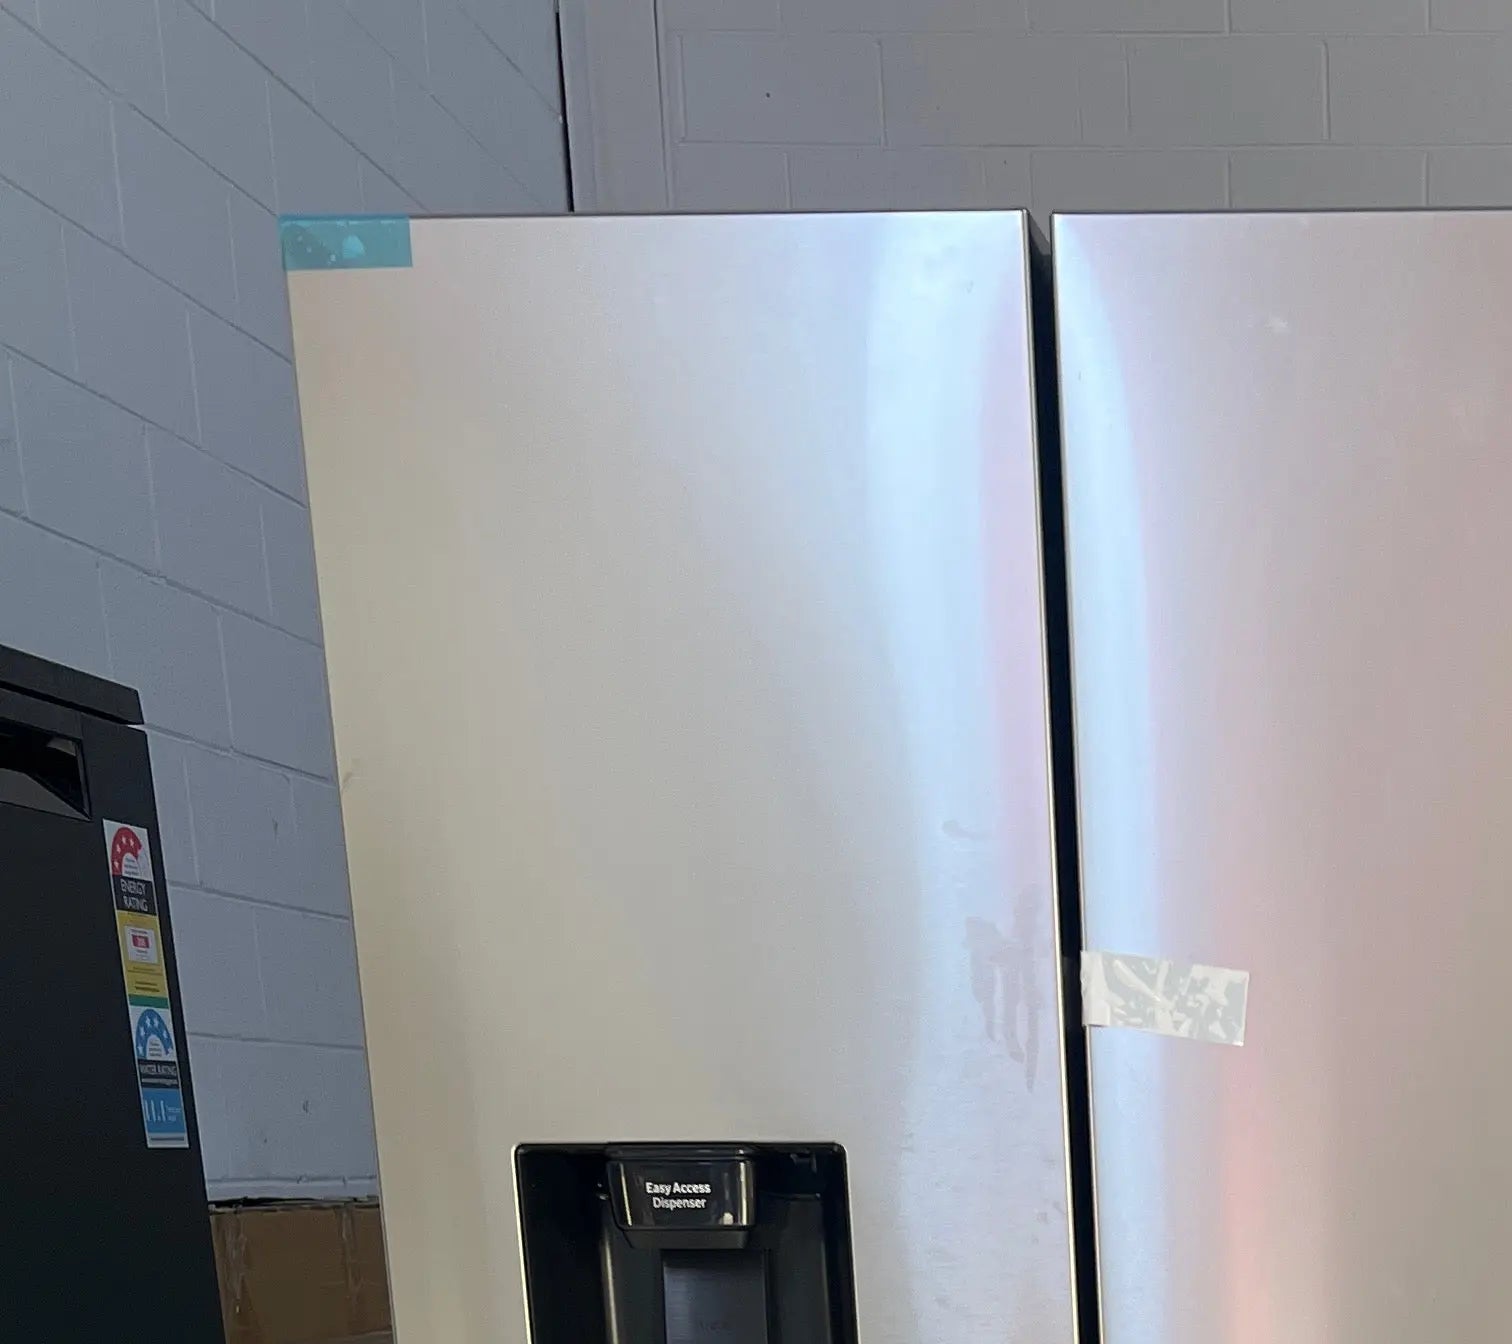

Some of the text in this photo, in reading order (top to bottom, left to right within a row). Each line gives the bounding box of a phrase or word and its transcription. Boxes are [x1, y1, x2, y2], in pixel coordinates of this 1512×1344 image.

[645, 1182, 712, 1196] Easy Access
[652, 1196, 707, 1211] Dispenser
